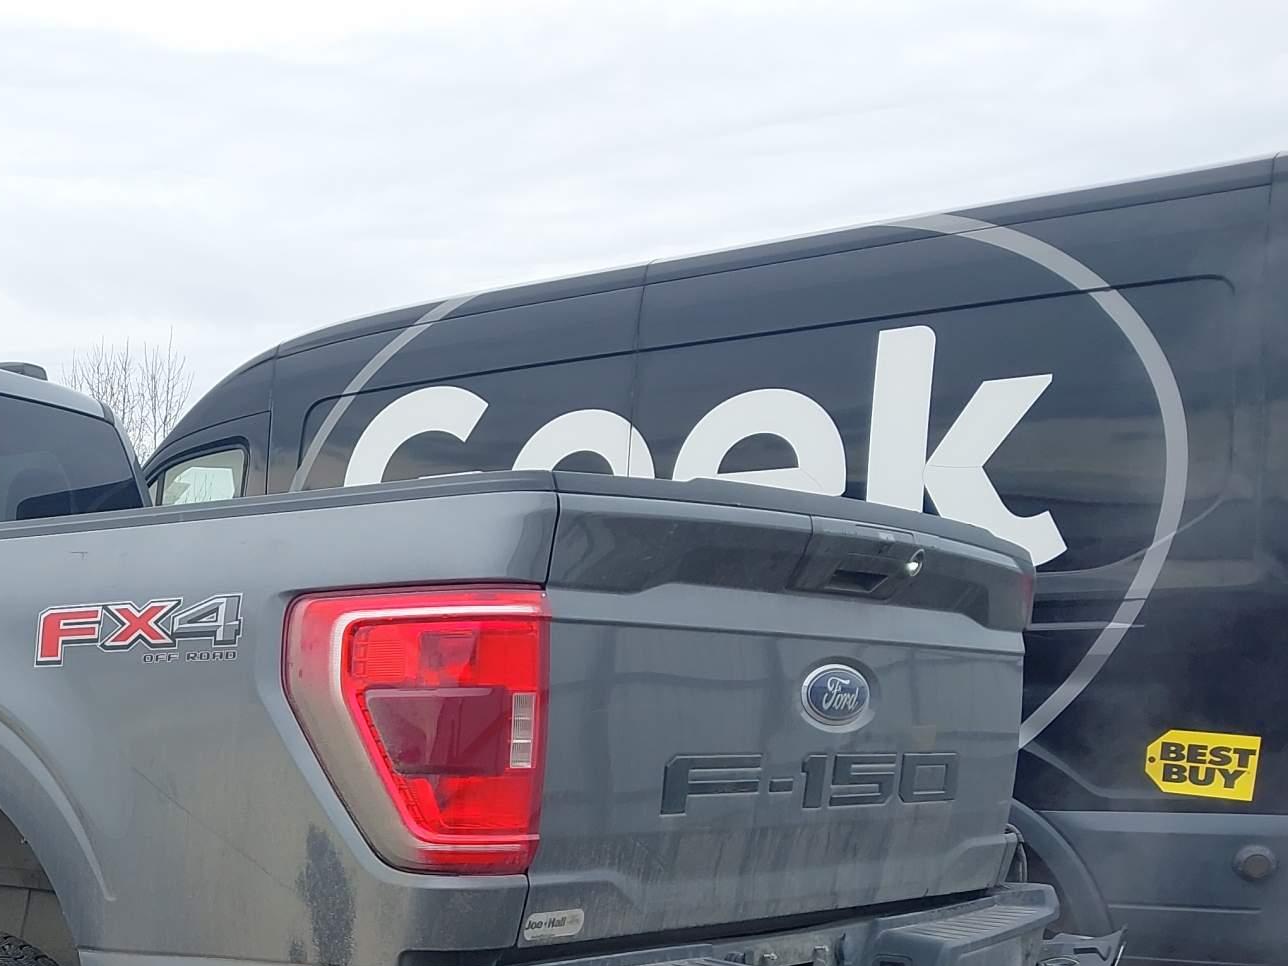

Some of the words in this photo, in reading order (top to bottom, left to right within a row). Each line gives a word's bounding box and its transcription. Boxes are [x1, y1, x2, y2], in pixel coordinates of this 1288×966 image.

[34, 593, 243, 668] FX4
[143, 653, 180, 664] OFF
[186, 650, 237, 662] ROAD
[821, 675, 860, 711] Ford
[1160, 741, 1257, 769] BEST
[660, 752, 959, 816] F-150
[1162, 763, 1248, 789] BUY
